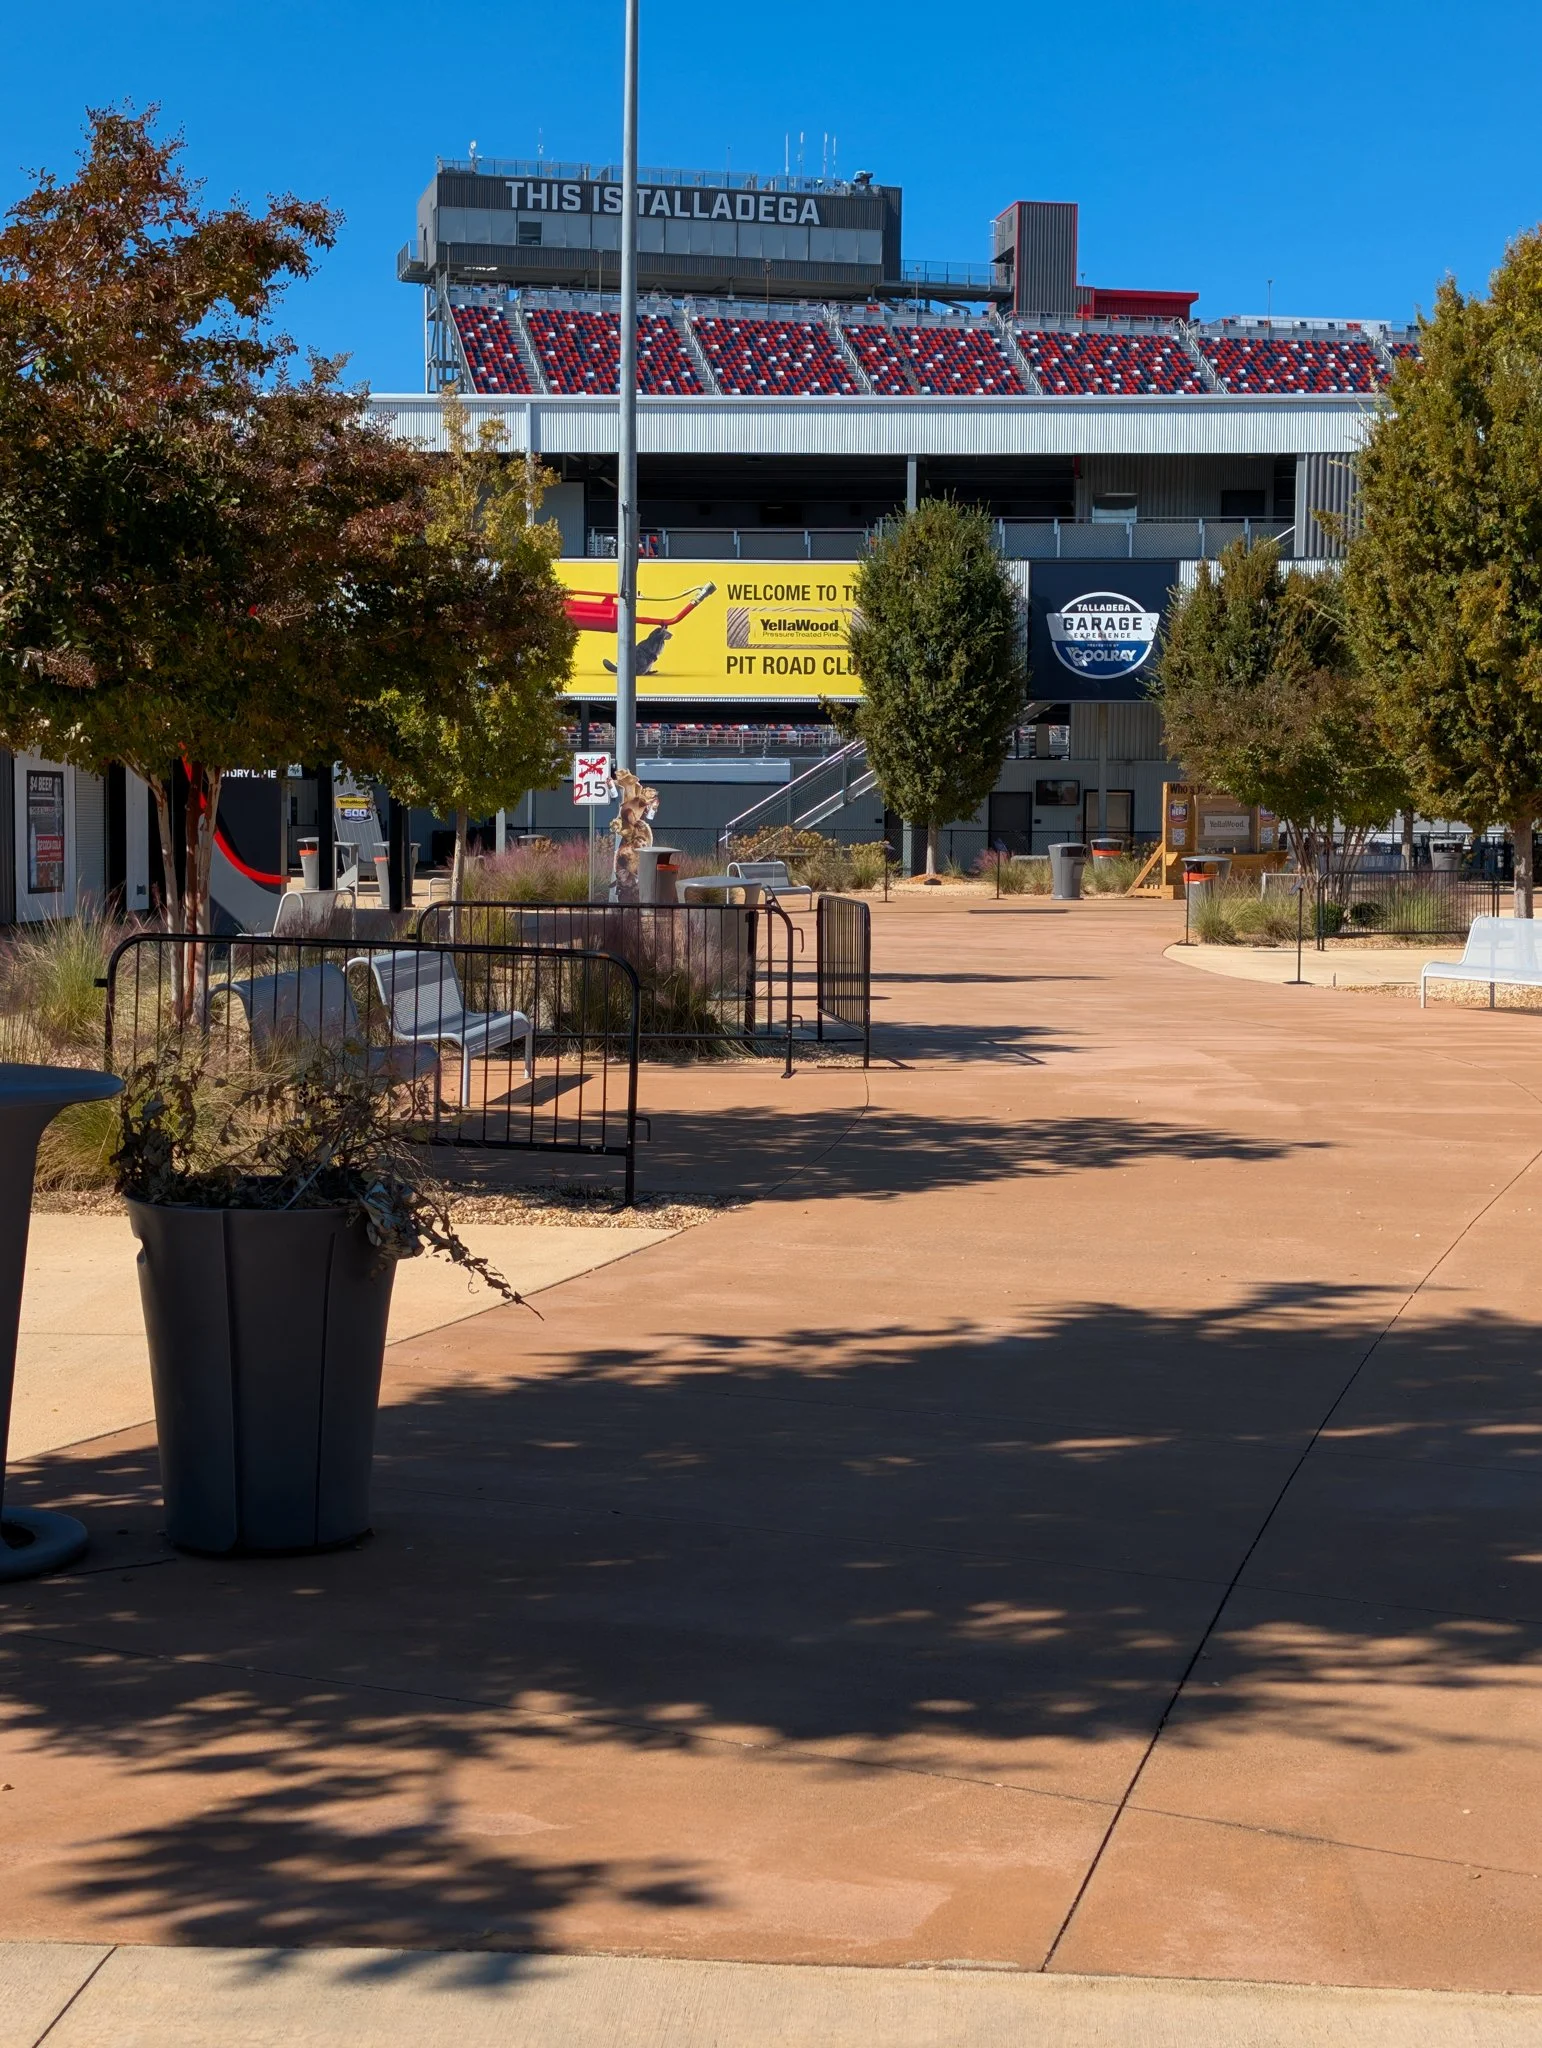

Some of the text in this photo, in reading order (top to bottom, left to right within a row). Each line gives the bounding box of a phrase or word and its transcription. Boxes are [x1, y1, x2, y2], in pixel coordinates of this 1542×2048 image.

[505, 181, 821, 226] THIS IS TALLADEGA
[727, 584, 811, 601] WELCOME
[816, 585, 837, 601] TO
[1077, 604, 1131, 612] TALLADEGA
[760, 619, 839, 632] YellaWood
[1063, 617, 1143, 631] GARAGE
[1072, 649, 1137, 662] COOLRAY
[726, 656, 757, 675] PIT
[763, 656, 816, 675] ROAD
[38, 776, 53, 791] BEER
[1170, 783, 1194, 794] Whos
[344, 809, 367, 818] 500
